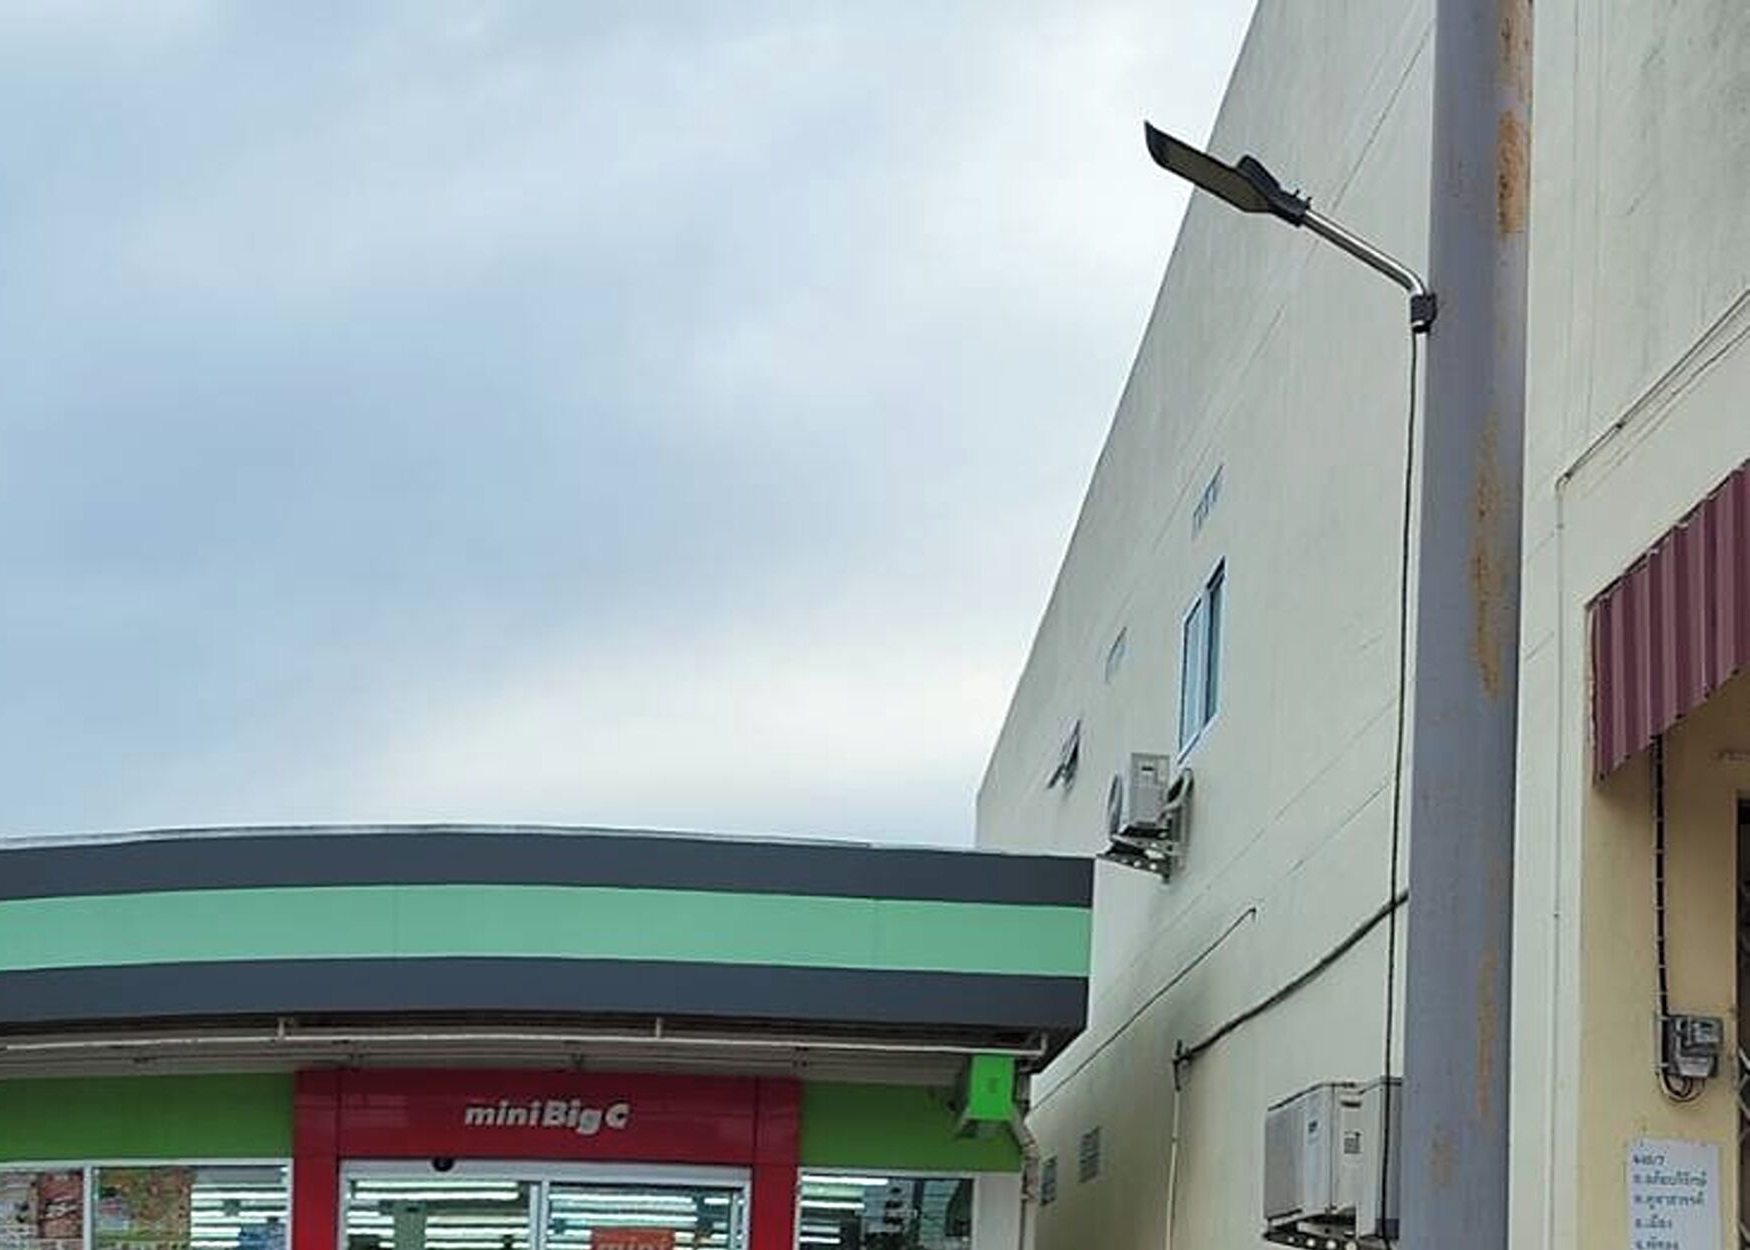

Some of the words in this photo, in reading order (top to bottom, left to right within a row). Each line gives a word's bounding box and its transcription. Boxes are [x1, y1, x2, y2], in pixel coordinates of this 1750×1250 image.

[465, 1101, 541, 1126] mini
[541, 1099, 602, 1135] Big
[605, 1103, 630, 1129] C
